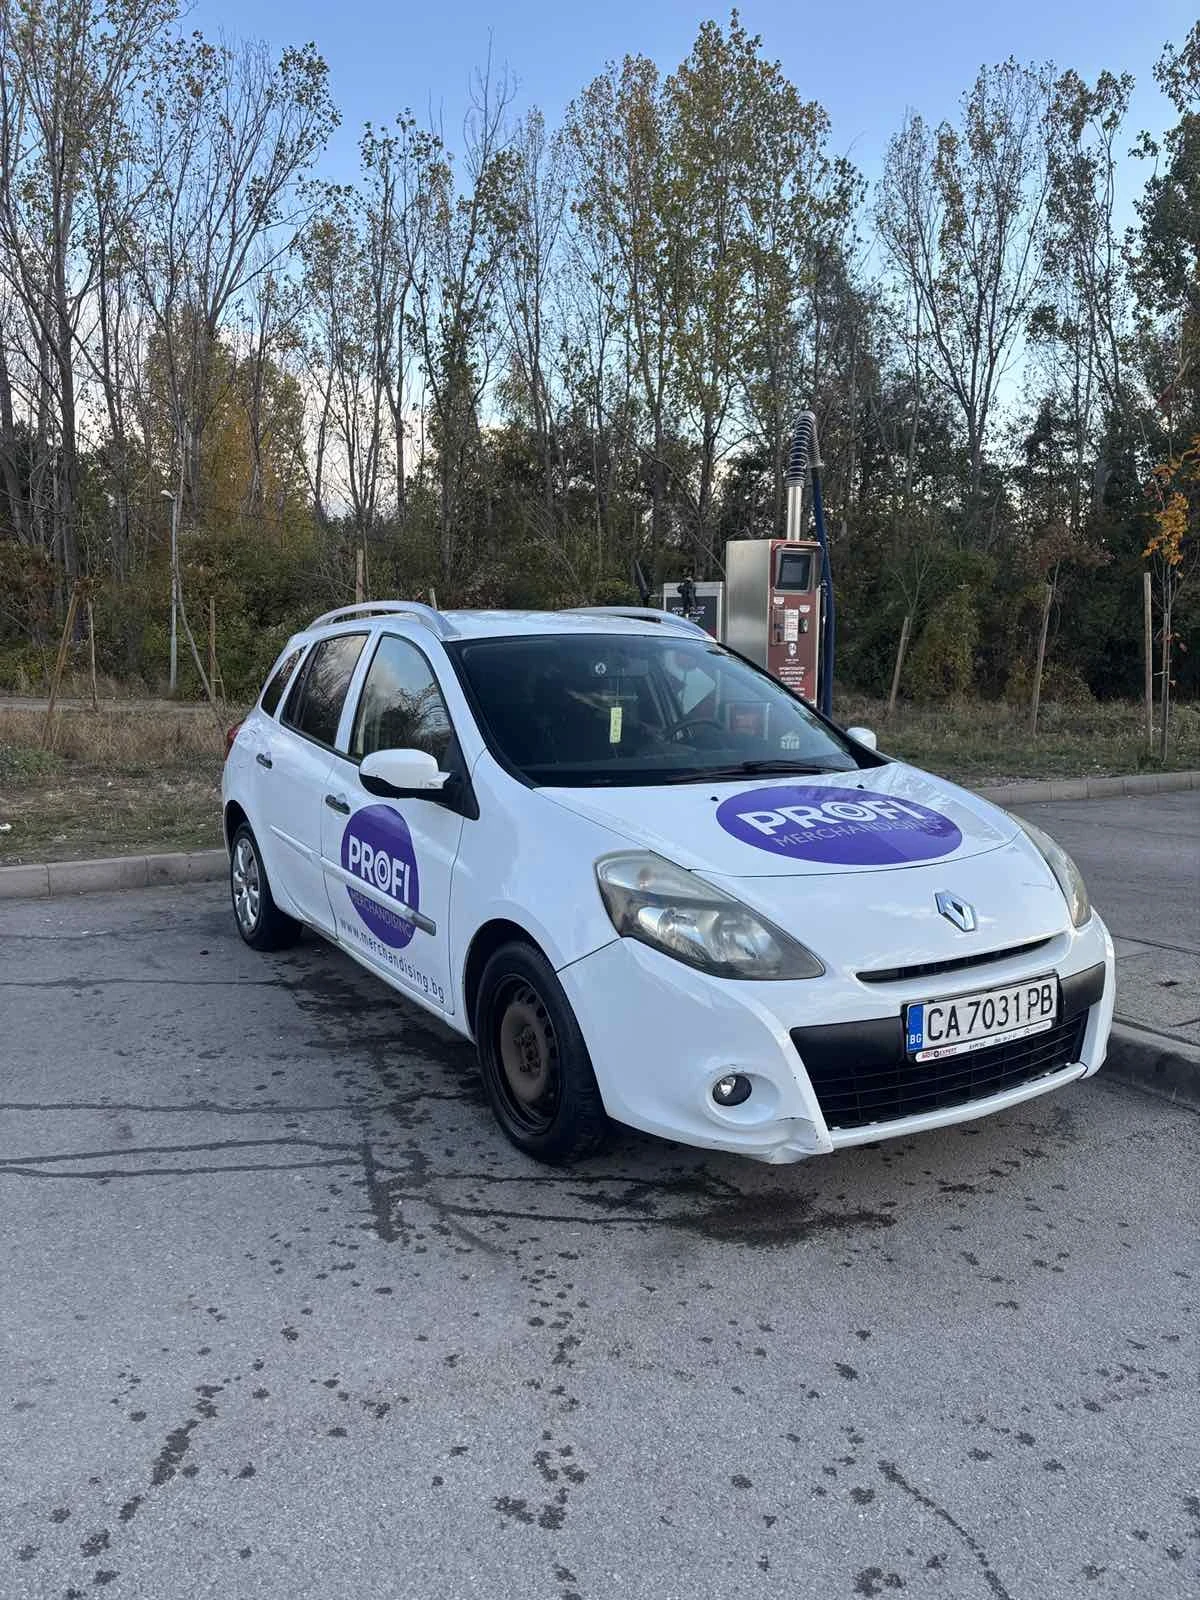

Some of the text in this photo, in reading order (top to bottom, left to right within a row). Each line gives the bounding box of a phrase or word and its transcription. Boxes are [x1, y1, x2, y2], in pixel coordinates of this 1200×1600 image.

[736, 800, 928, 836] PROFI
[773, 815, 943, 848] MERCHANDISING
[349, 834, 411, 904] PROFI
[340, 917, 444, 1004] www.merchandising.bg
[909, 1033, 922, 1045] BG
